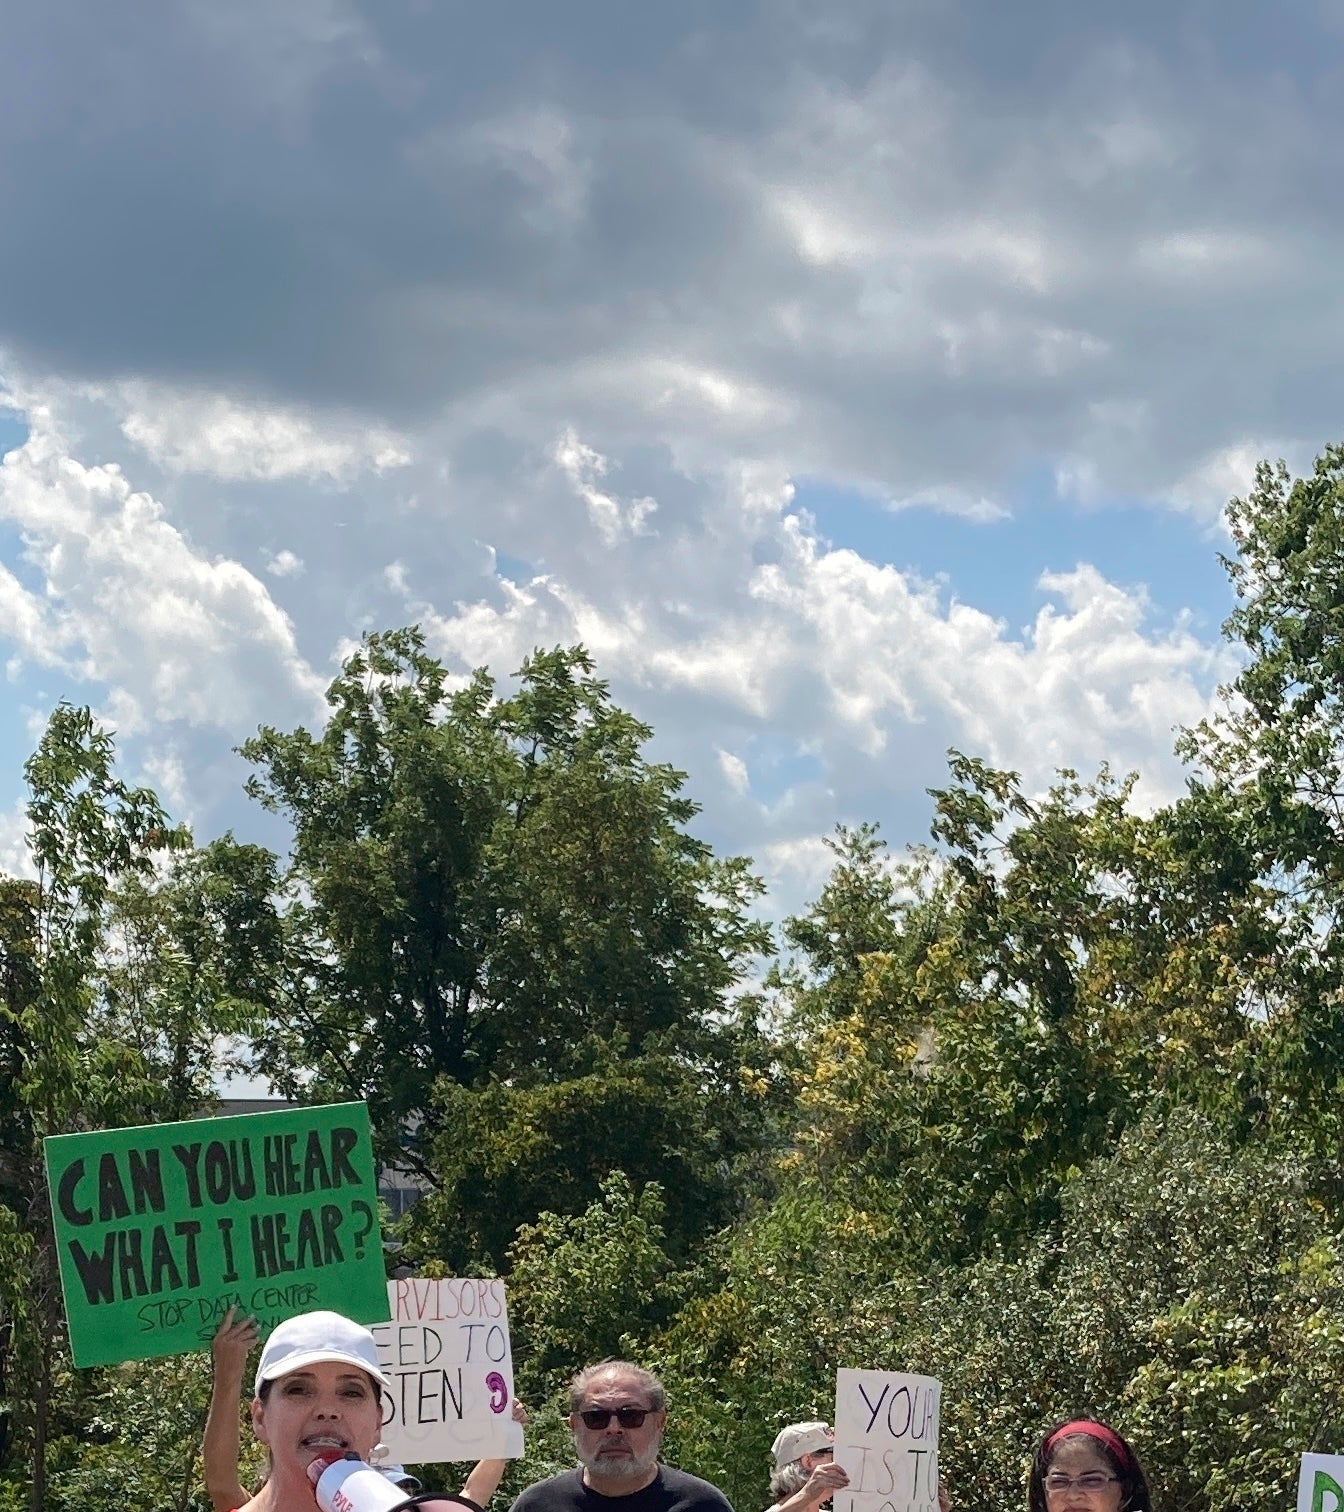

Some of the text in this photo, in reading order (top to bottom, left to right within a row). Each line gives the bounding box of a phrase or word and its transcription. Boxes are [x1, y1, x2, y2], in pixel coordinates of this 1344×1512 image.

[58, 1127, 363, 1227] CAN YOU HEAR
[68, 1200, 375, 1306] WHAT I HEAR?
[137, 1298, 194, 1331] STOP
[198, 1293, 248, 1323] DATA
[250, 1282, 320, 1311] CENTER
[393, 1278, 503, 1322] RVISORS
[372, 1324, 506, 1366] EED TO
[382, 1367, 463, 1427] STEN
[844, 1446, 894, 1496] IS
